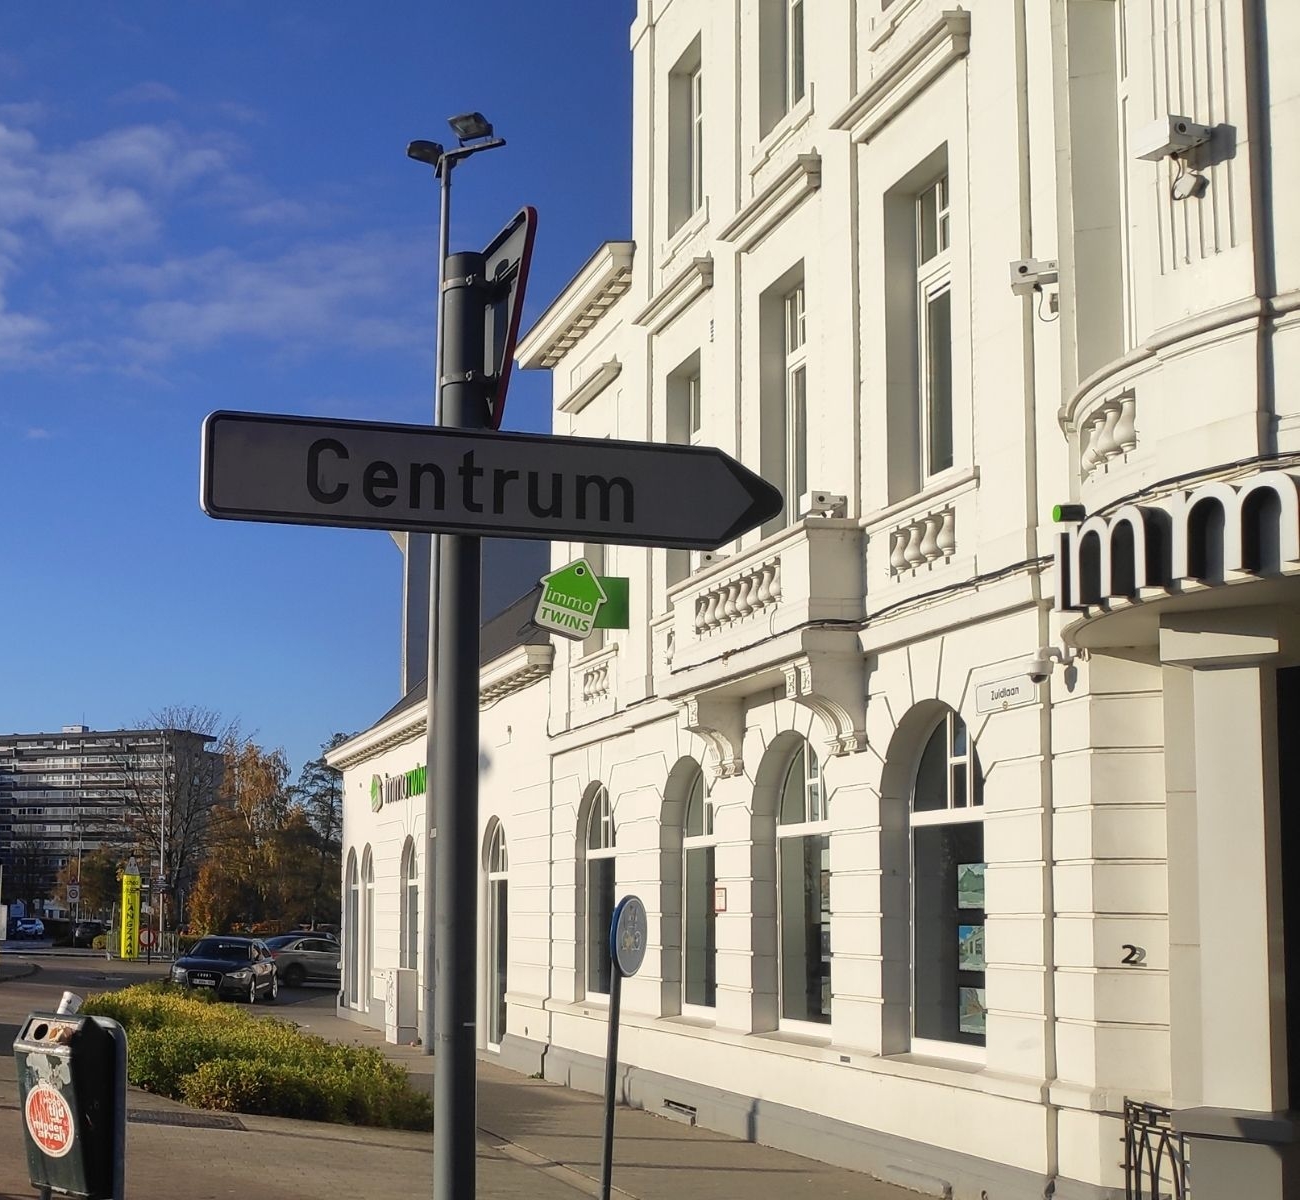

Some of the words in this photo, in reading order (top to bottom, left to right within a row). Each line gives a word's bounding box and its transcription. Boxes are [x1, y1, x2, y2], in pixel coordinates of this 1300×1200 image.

[306, 438, 634, 523] Centrum
[546, 587, 593, 612] immo
[541, 607, 590, 632] TWINS
[991, 687, 1019, 700] Zuidlaan
[385, 765, 427, 804] immoTWIN
[125, 898, 134, 955] LANGZAAM
[48, 1104, 65, 1121] tijd
[33, 1119, 63, 1132] minder
